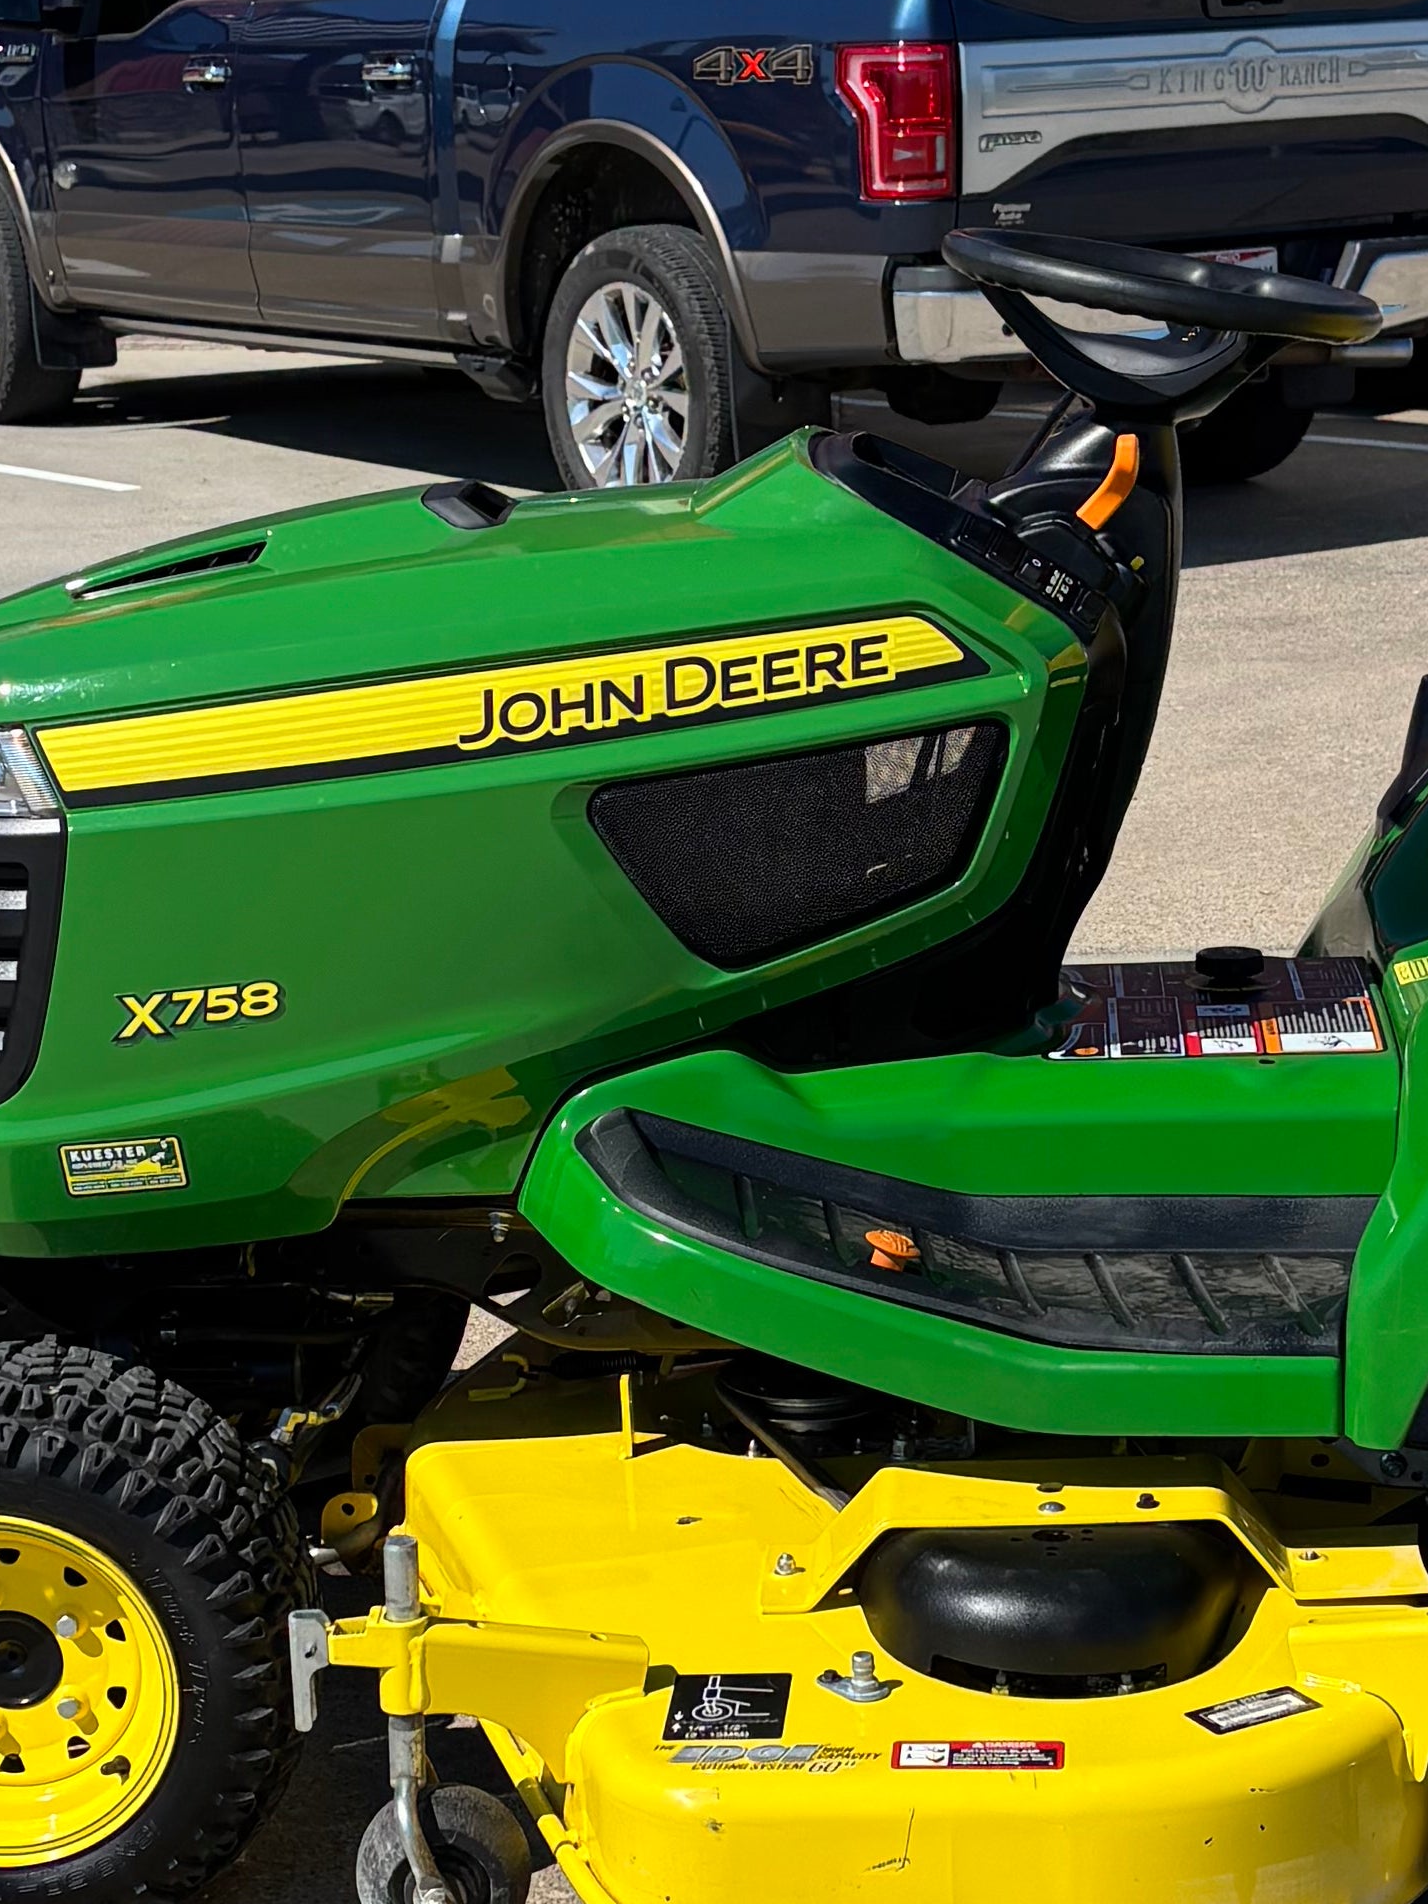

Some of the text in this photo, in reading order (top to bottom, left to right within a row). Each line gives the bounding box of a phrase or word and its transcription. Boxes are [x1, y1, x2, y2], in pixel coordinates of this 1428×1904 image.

[1158, 57, 1341, 95] KING RANCH
[458, 633, 889, 745] JOHN DEERE
[117, 981, 279, 1039] X758
[69, 1145, 147, 1162] KUESTER
